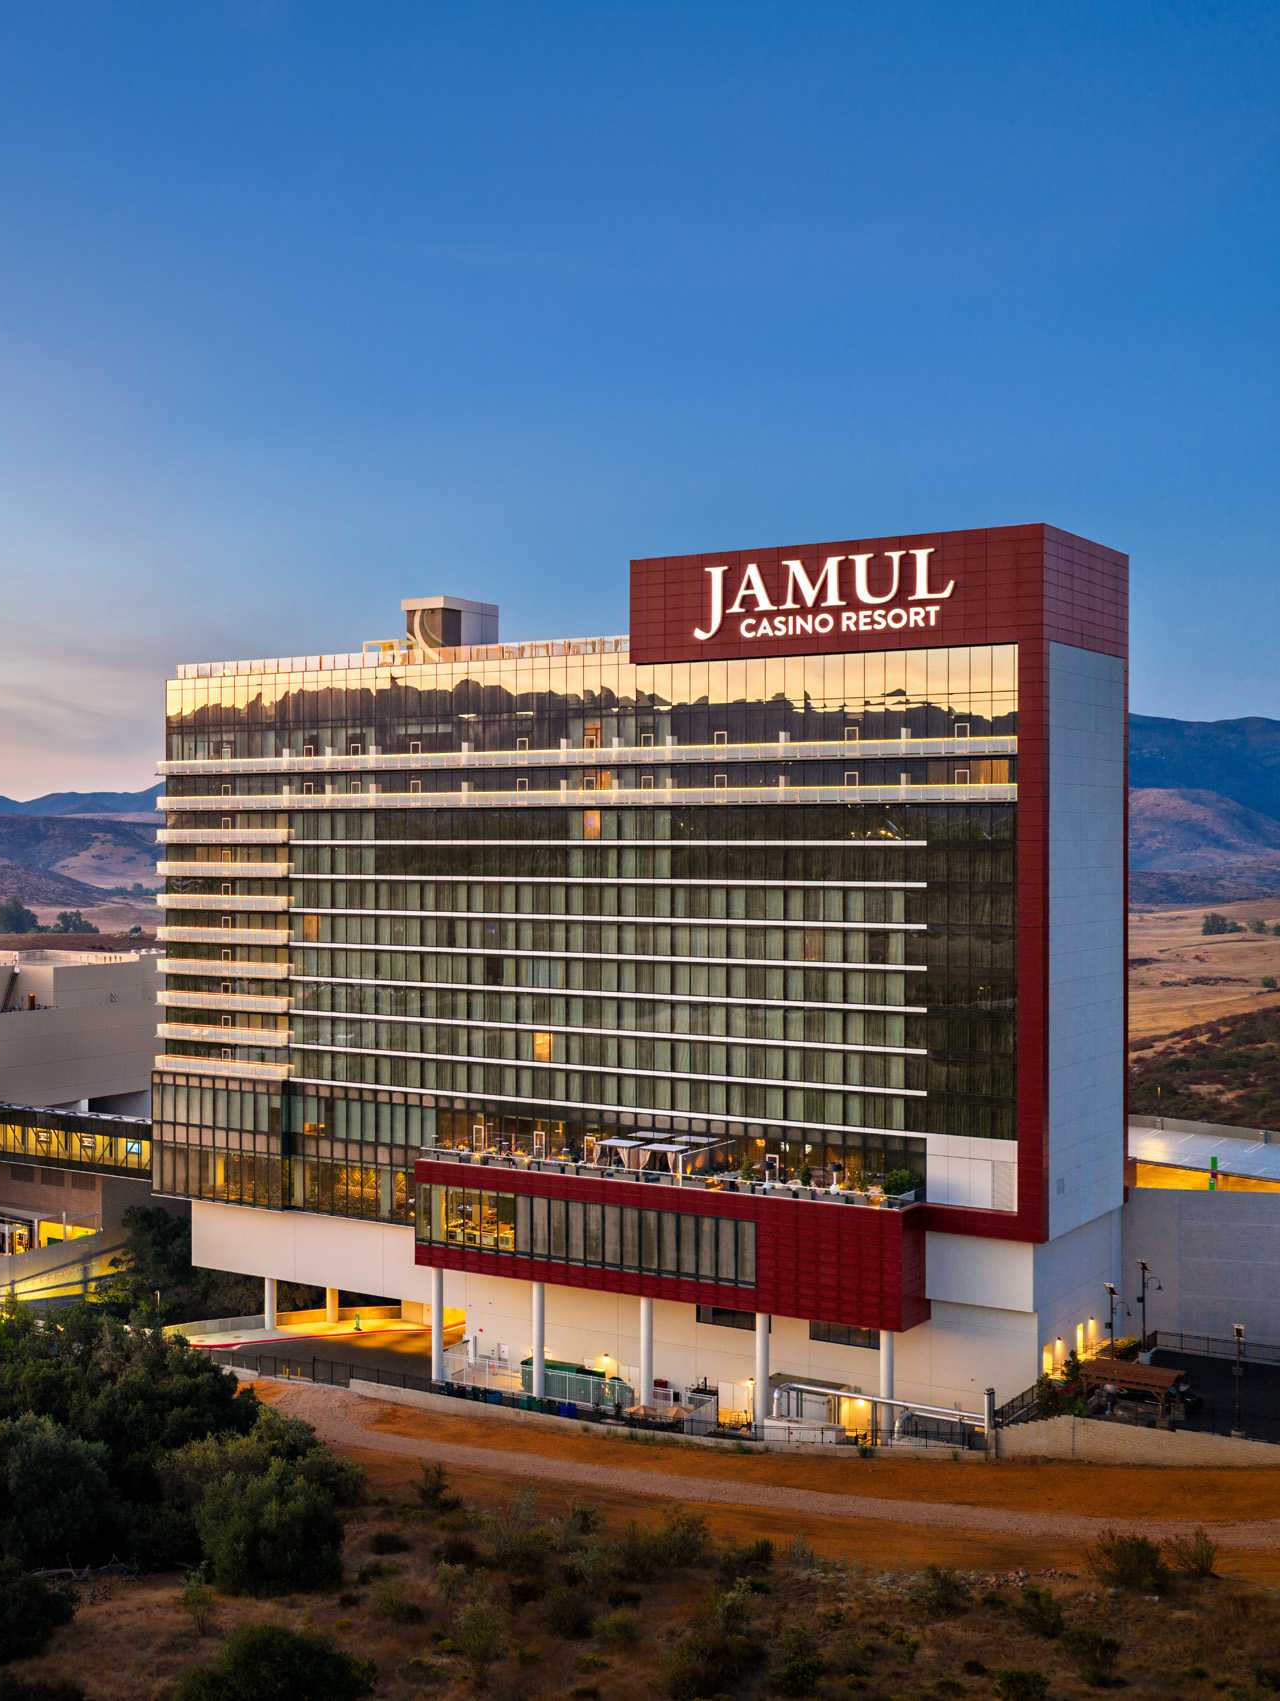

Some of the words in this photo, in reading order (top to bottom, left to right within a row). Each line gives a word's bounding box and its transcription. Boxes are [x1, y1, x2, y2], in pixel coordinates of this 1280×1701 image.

[693, 547, 955, 641] JAMUL
[739, 613, 834, 639] CASINO
[841, 605, 940, 632] RESORT
